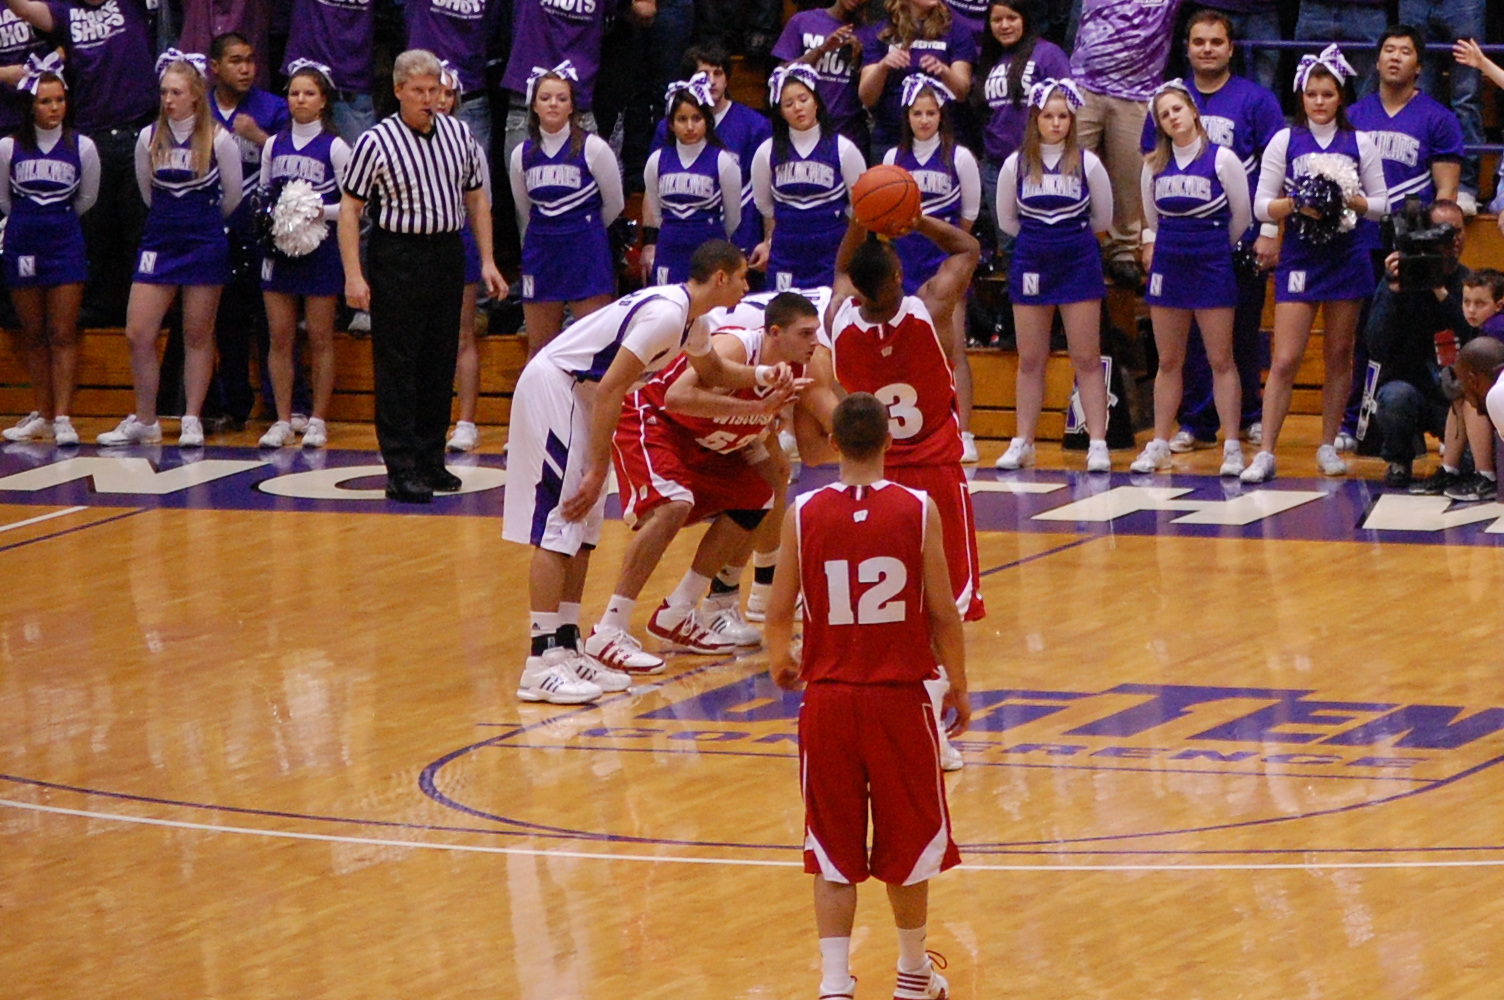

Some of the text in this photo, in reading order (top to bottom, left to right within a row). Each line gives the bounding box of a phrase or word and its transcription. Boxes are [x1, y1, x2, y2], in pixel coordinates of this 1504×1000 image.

[70, 12, 125, 43] SHOTS
[774, 160, 835, 188] WILDCATS
[824, 556, 907, 626] 12
